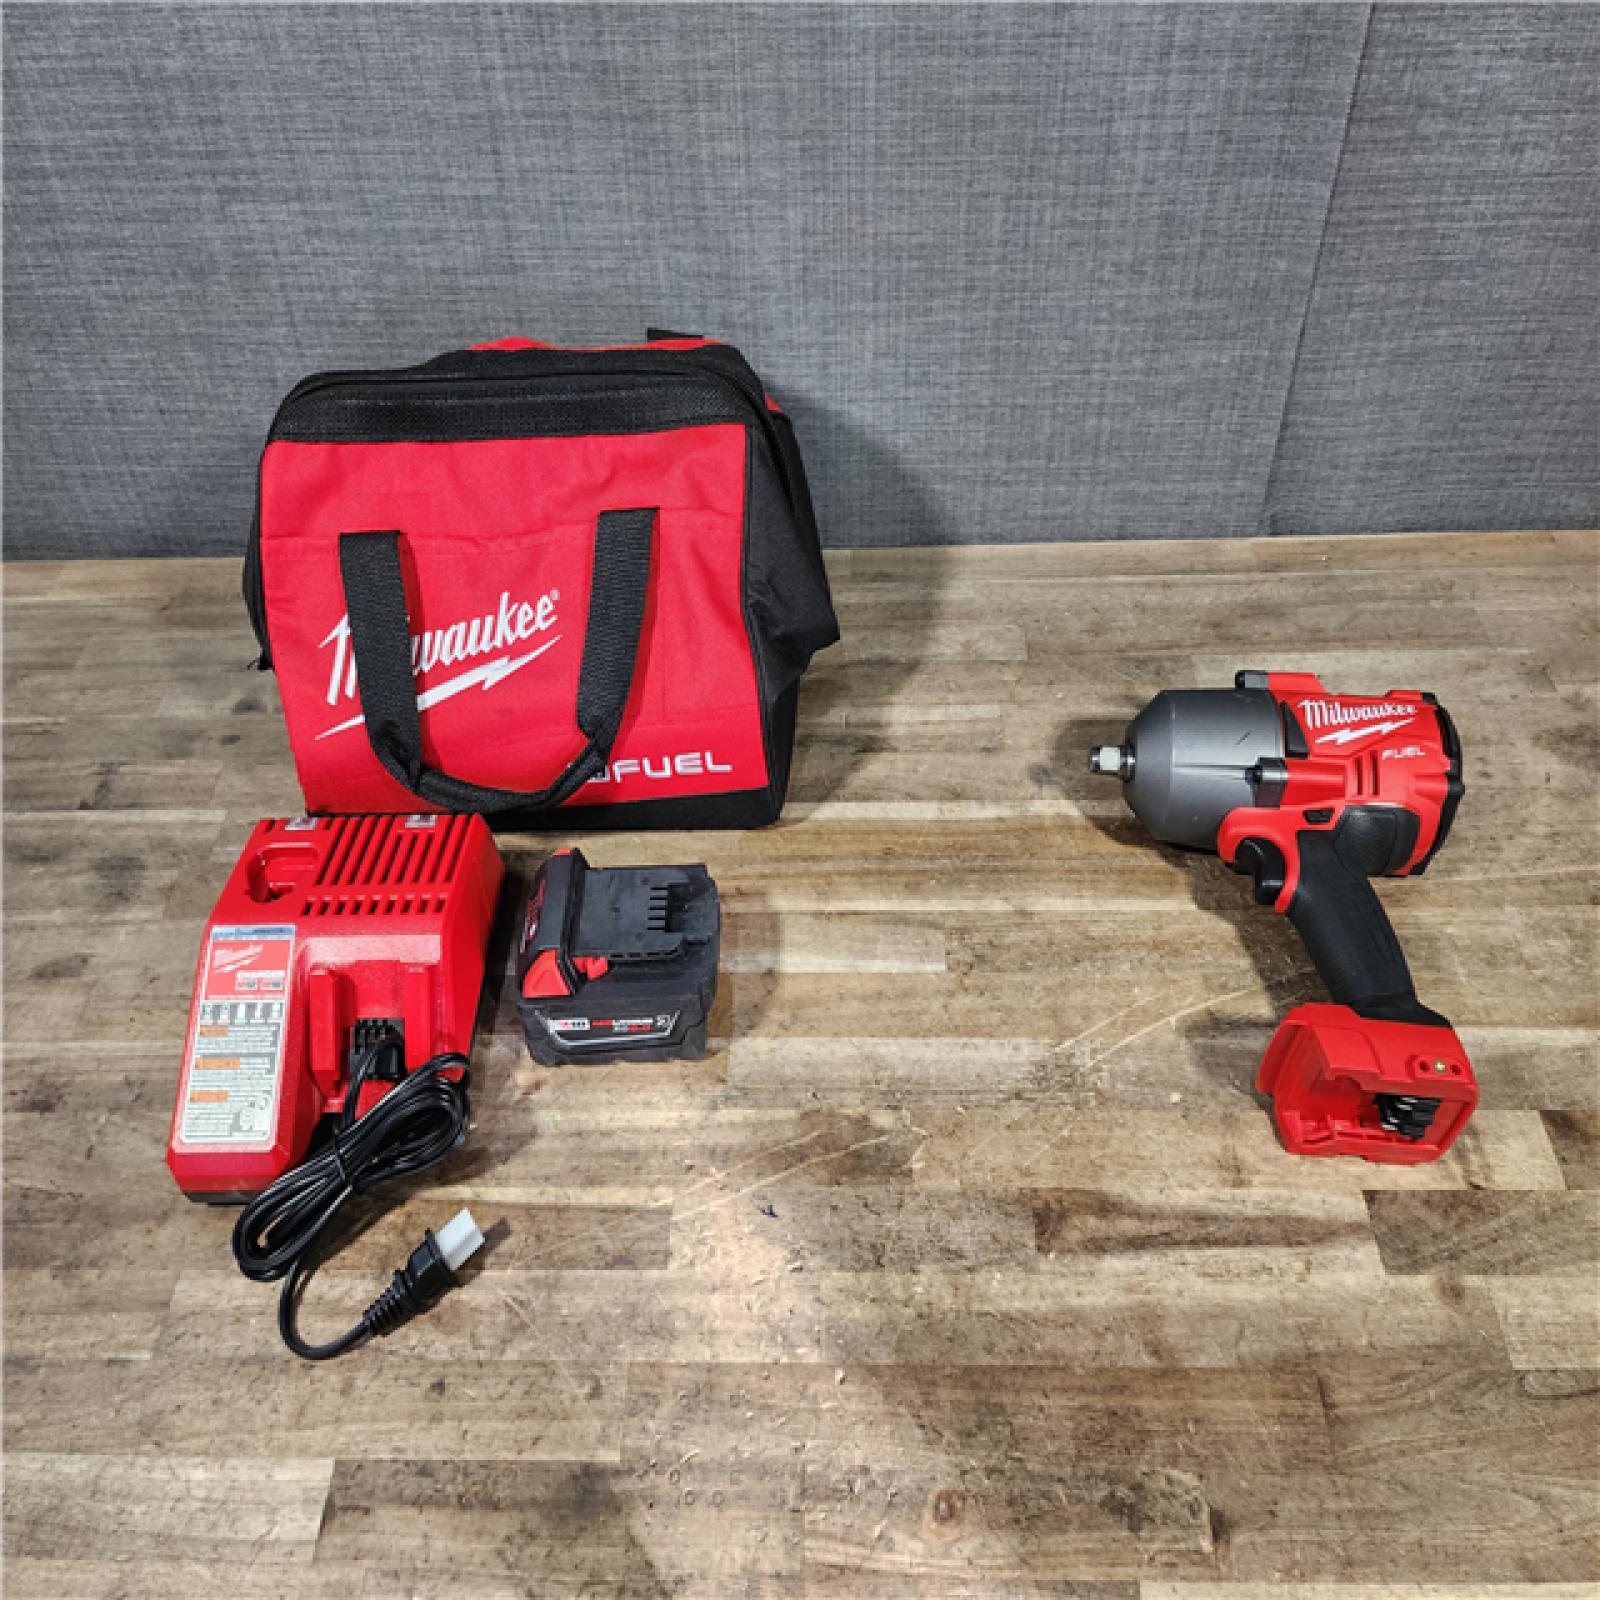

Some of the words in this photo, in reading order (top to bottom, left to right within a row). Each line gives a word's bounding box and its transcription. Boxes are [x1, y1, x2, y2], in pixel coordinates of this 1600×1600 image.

[1297, 699, 1416, 730] Milwaukee
[613, 751, 732, 783] FUEL
[1382, 746, 1425, 759] FUEL
